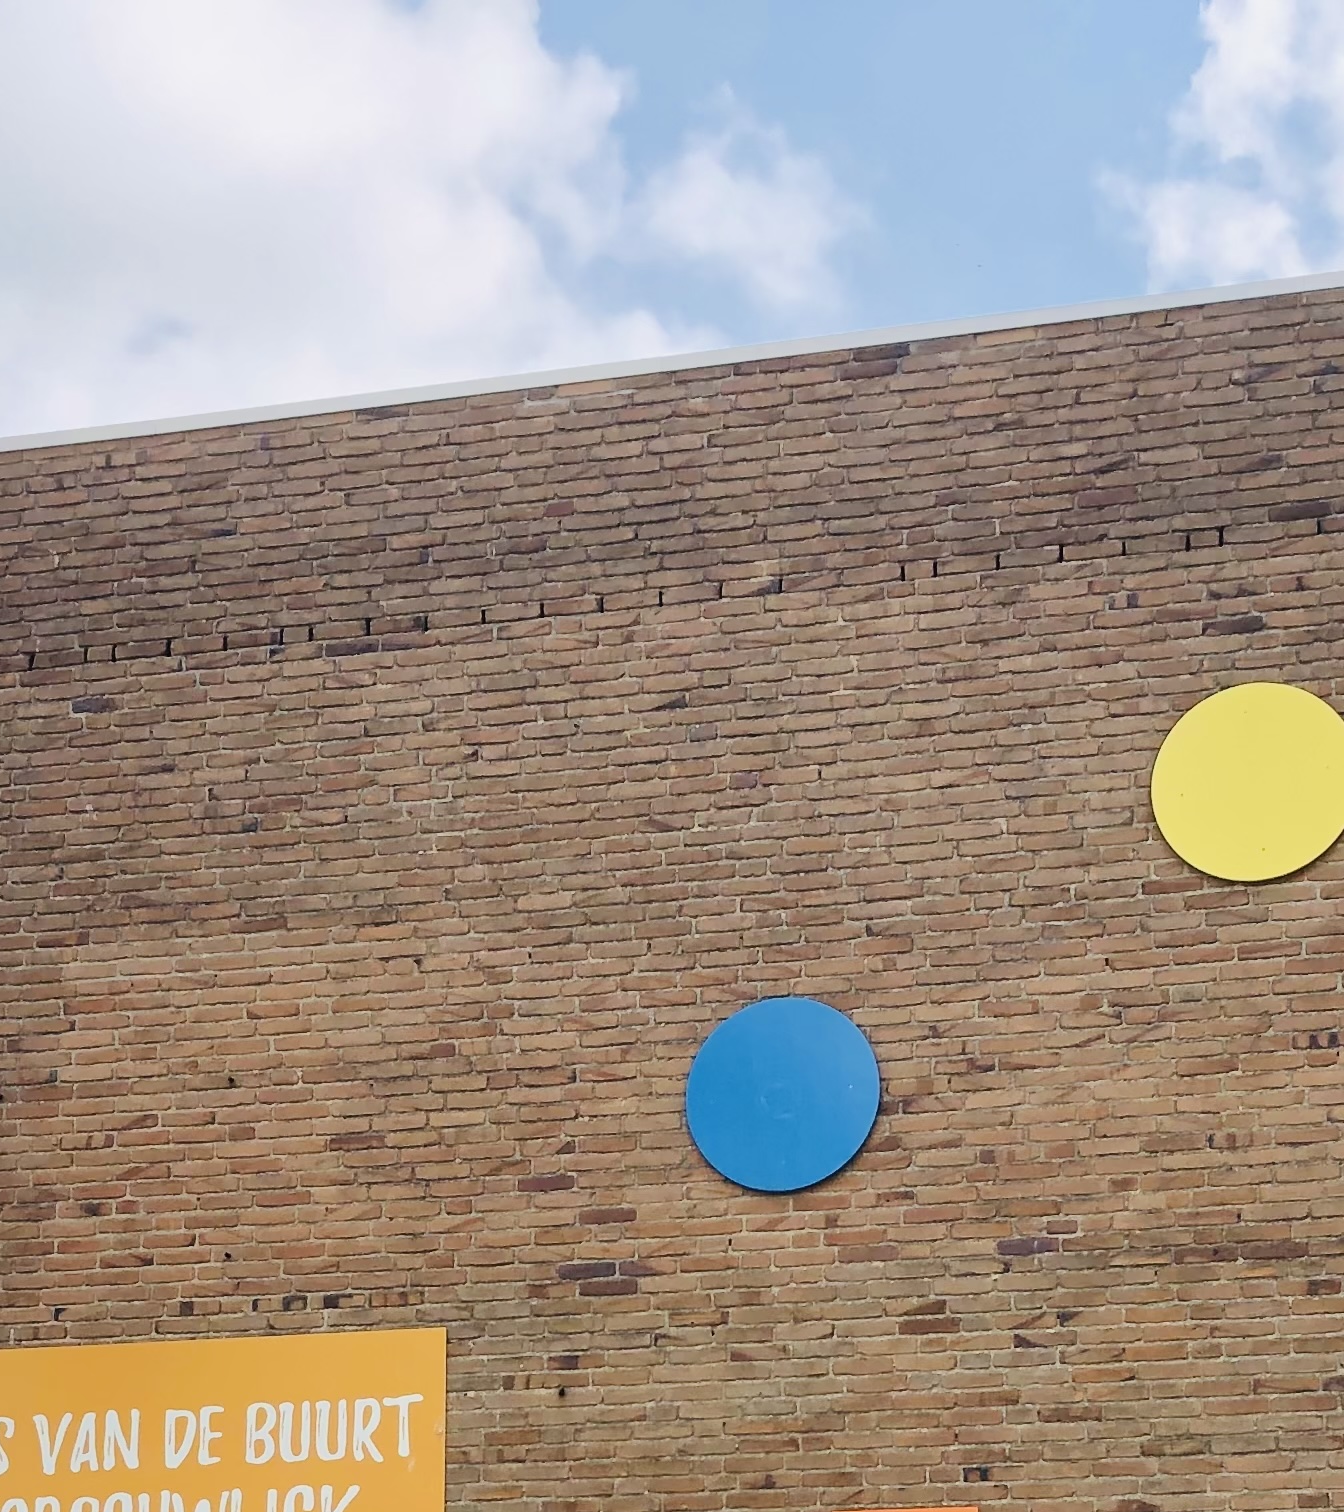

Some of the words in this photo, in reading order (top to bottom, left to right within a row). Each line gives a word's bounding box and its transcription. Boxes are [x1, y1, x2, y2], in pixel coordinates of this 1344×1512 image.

[32, 1407, 141, 1476] VAN
[163, 1404, 225, 1470] DE
[243, 1393, 424, 1466] BUURT
